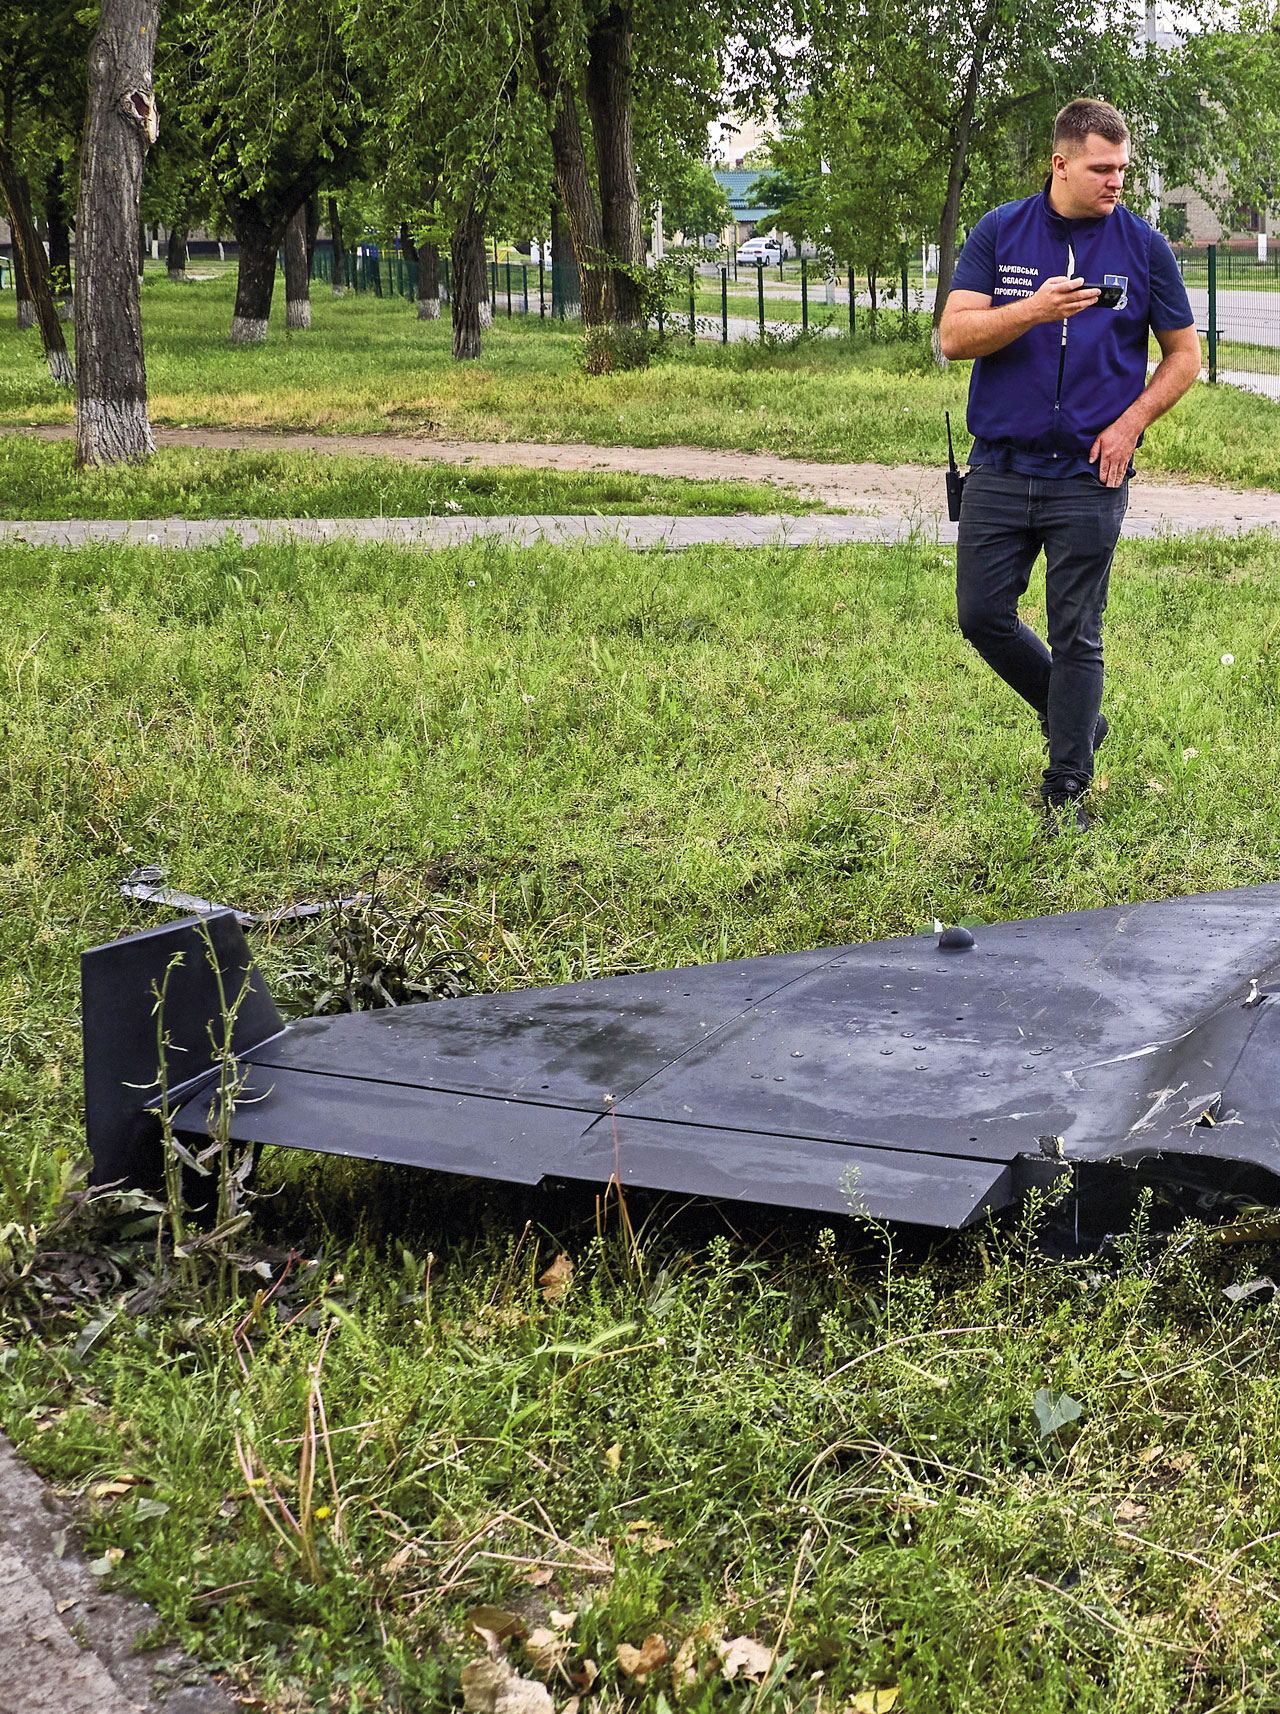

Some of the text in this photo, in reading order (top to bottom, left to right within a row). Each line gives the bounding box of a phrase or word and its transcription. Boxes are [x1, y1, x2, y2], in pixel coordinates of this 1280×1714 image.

[998, 264, 1039, 276] ХАРКІВСЬКА
[1001, 276, 1033, 287] ОБЛАСНА
[994, 287, 1037, 298] ПРОКУРАТУР
